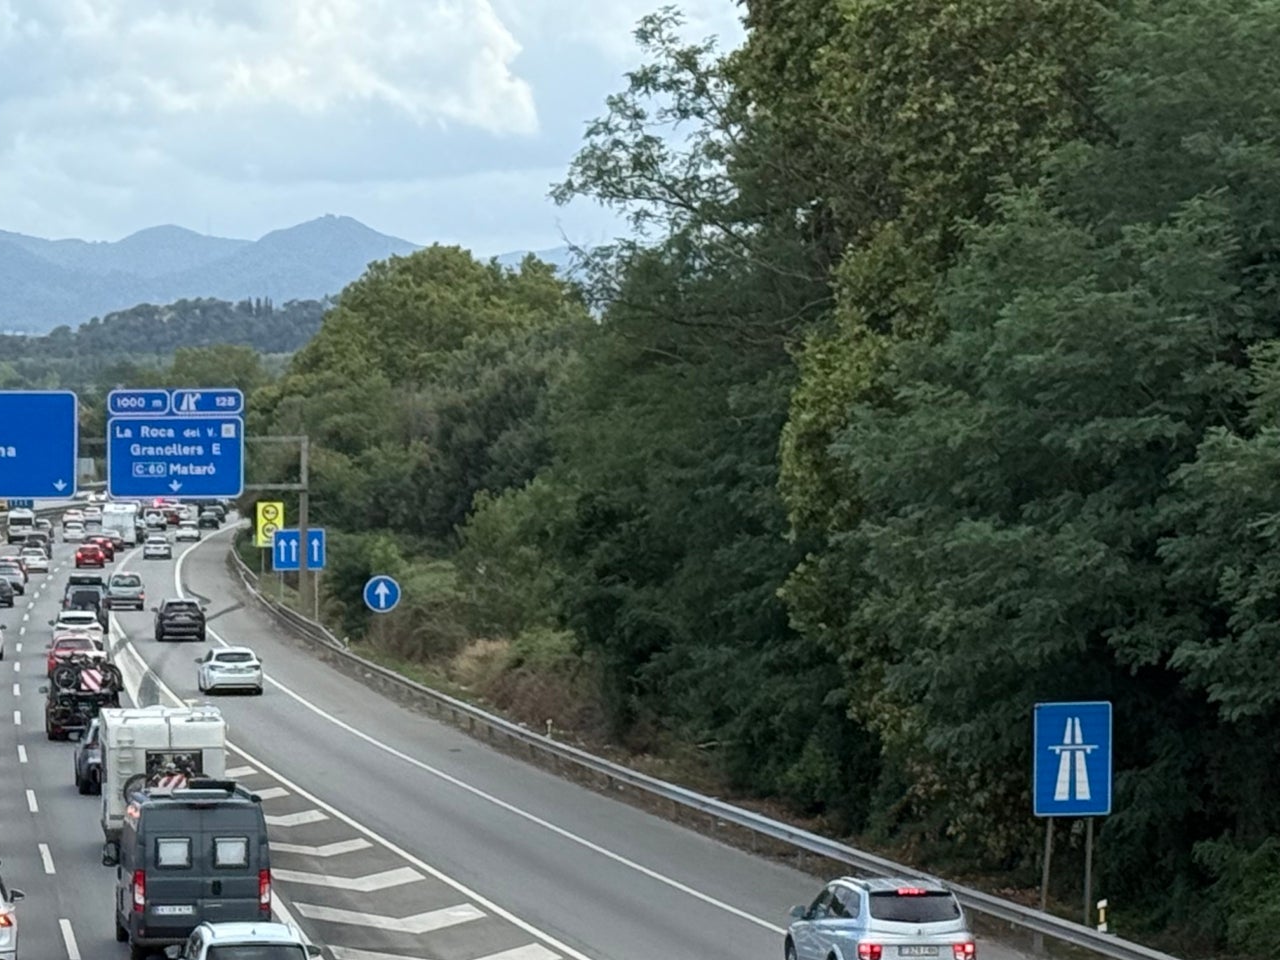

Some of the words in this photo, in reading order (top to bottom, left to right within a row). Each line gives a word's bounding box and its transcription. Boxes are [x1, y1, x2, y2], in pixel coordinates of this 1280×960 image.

[116, 397, 146, 408] 1000
[115, 425, 132, 438] La
[140, 425, 175, 438] Roca
[183, 427, 201, 438] del
[130, 443, 205, 456] Granollers
[211, 443, 222, 455] E
[169, 462, 216, 476] Mataró
